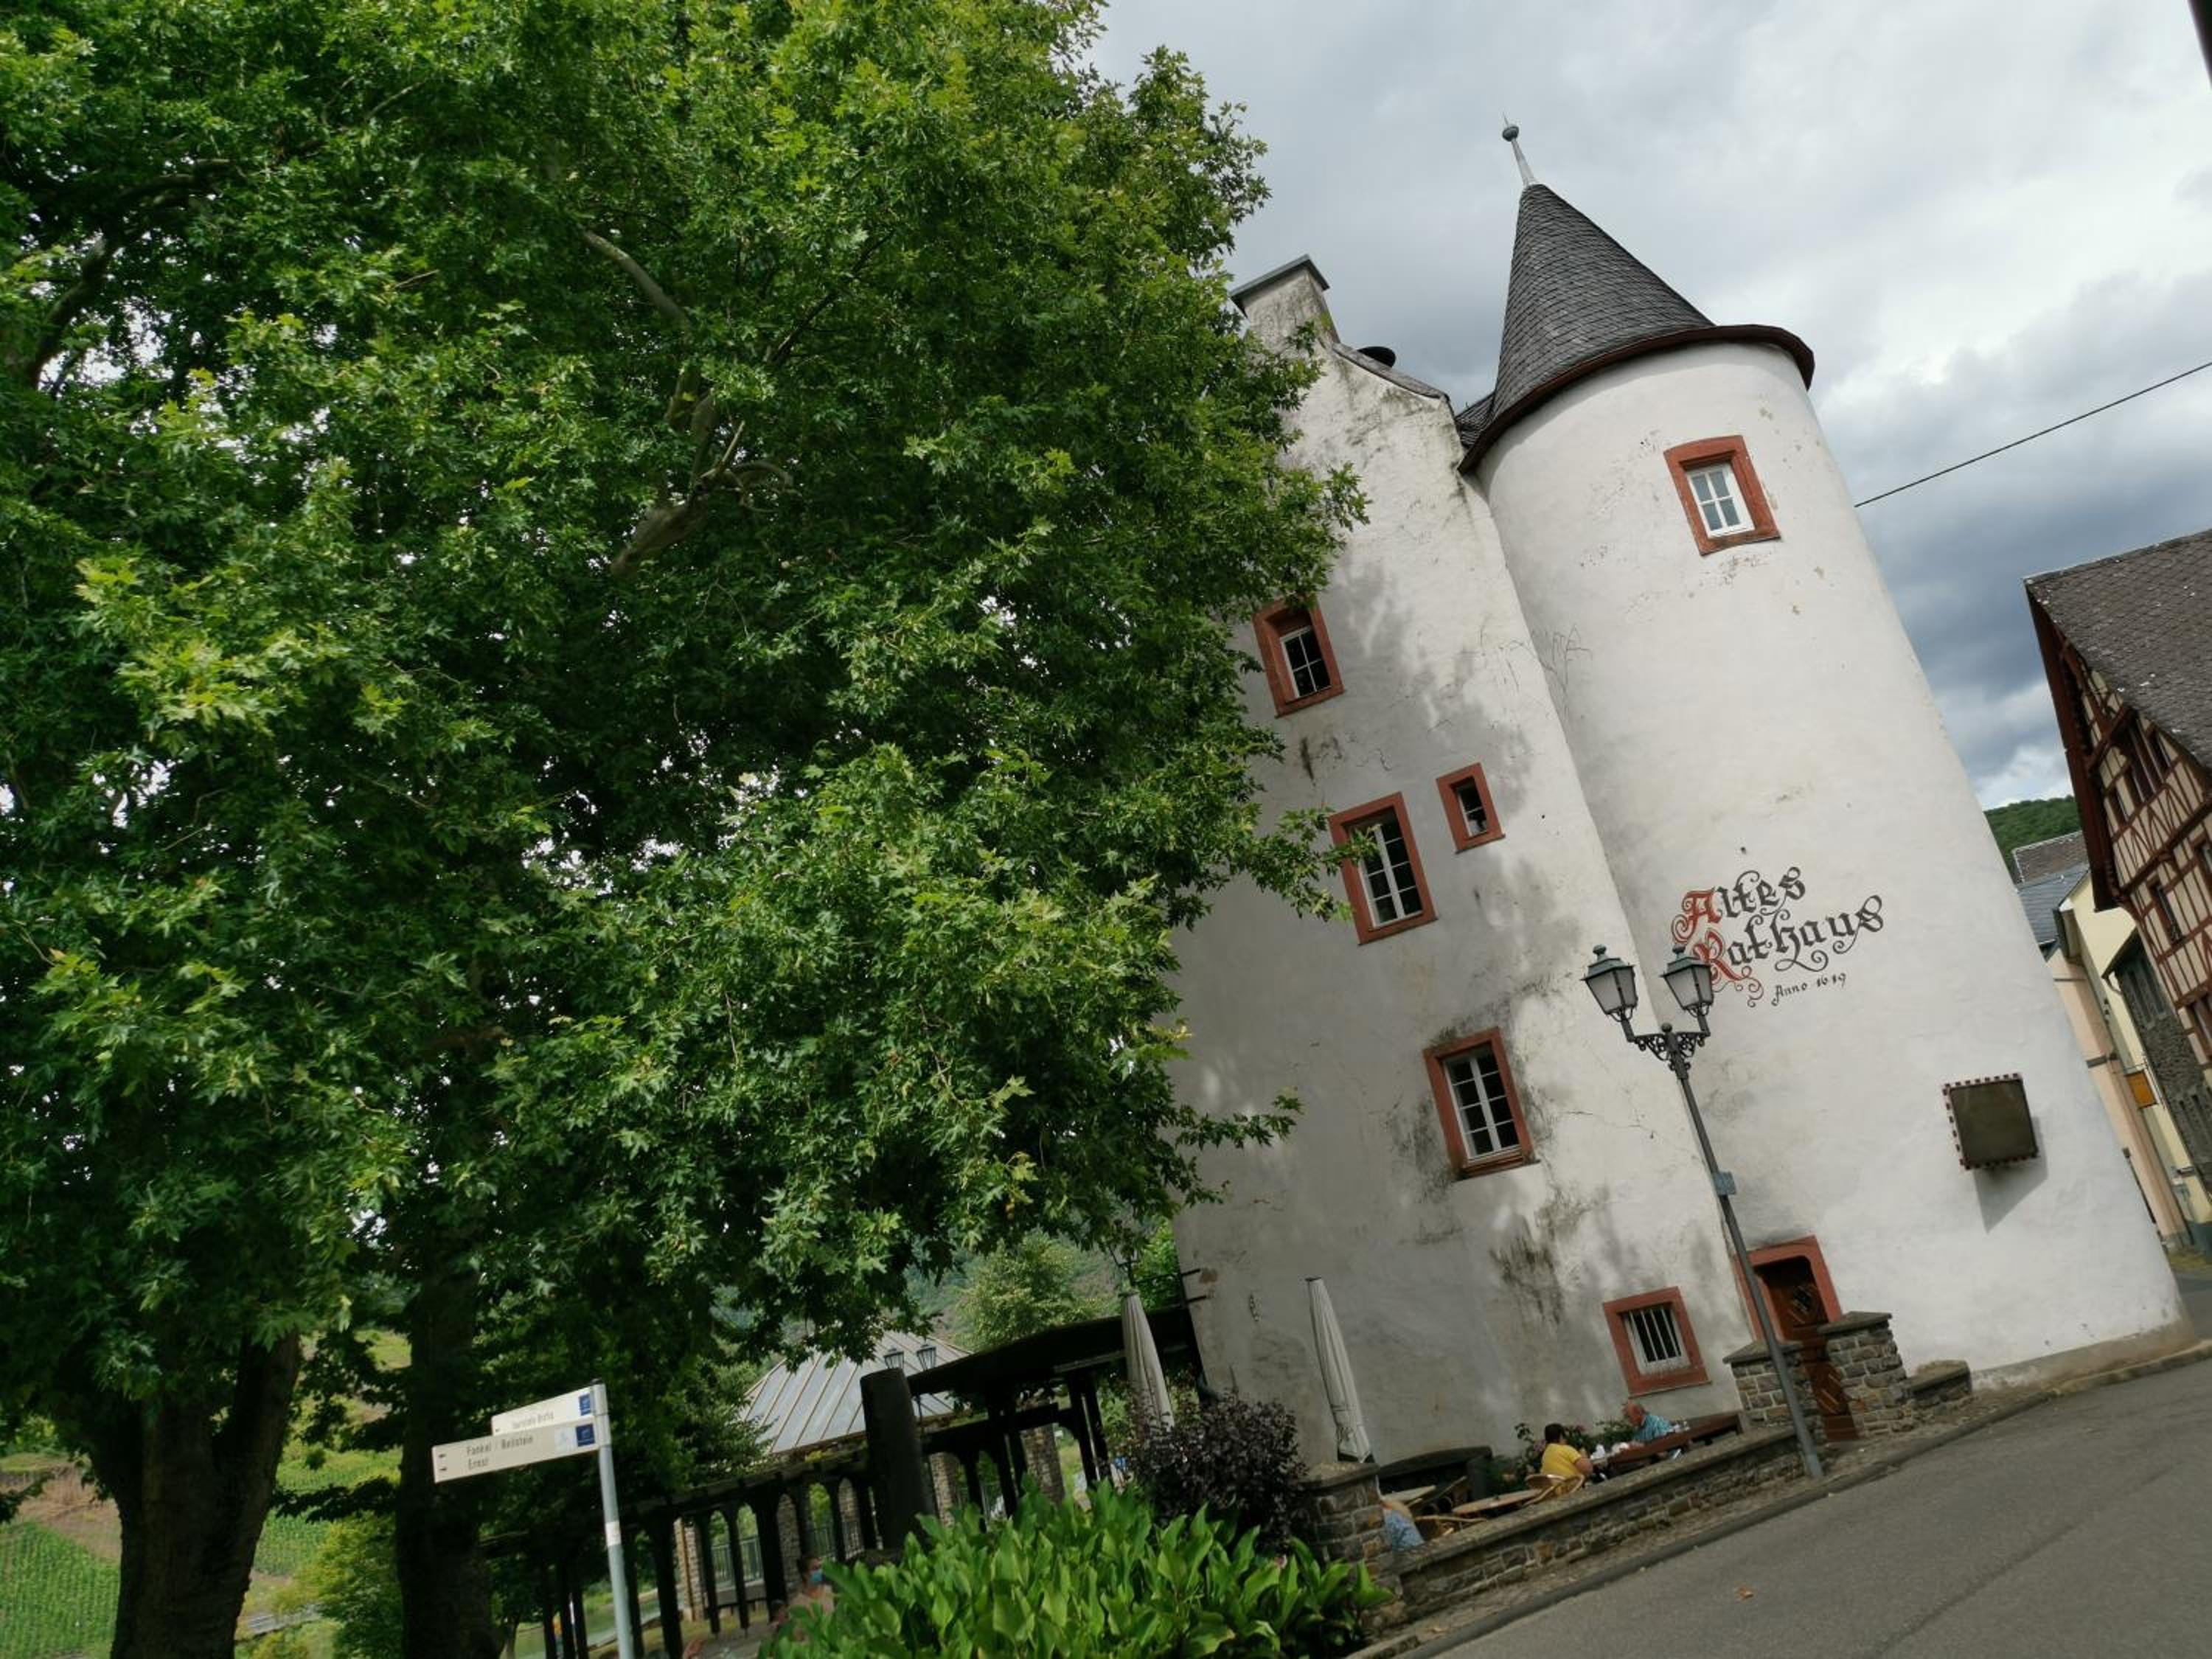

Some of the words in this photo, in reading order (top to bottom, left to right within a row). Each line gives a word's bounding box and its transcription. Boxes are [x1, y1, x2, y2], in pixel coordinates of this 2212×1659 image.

[1672, 866, 1806, 943] Altes
[1691, 894, 1884, 1007] Rathaus
[1771, 982, 1808, 1006] Anno
[1816, 973, 1846, 988] 1619
